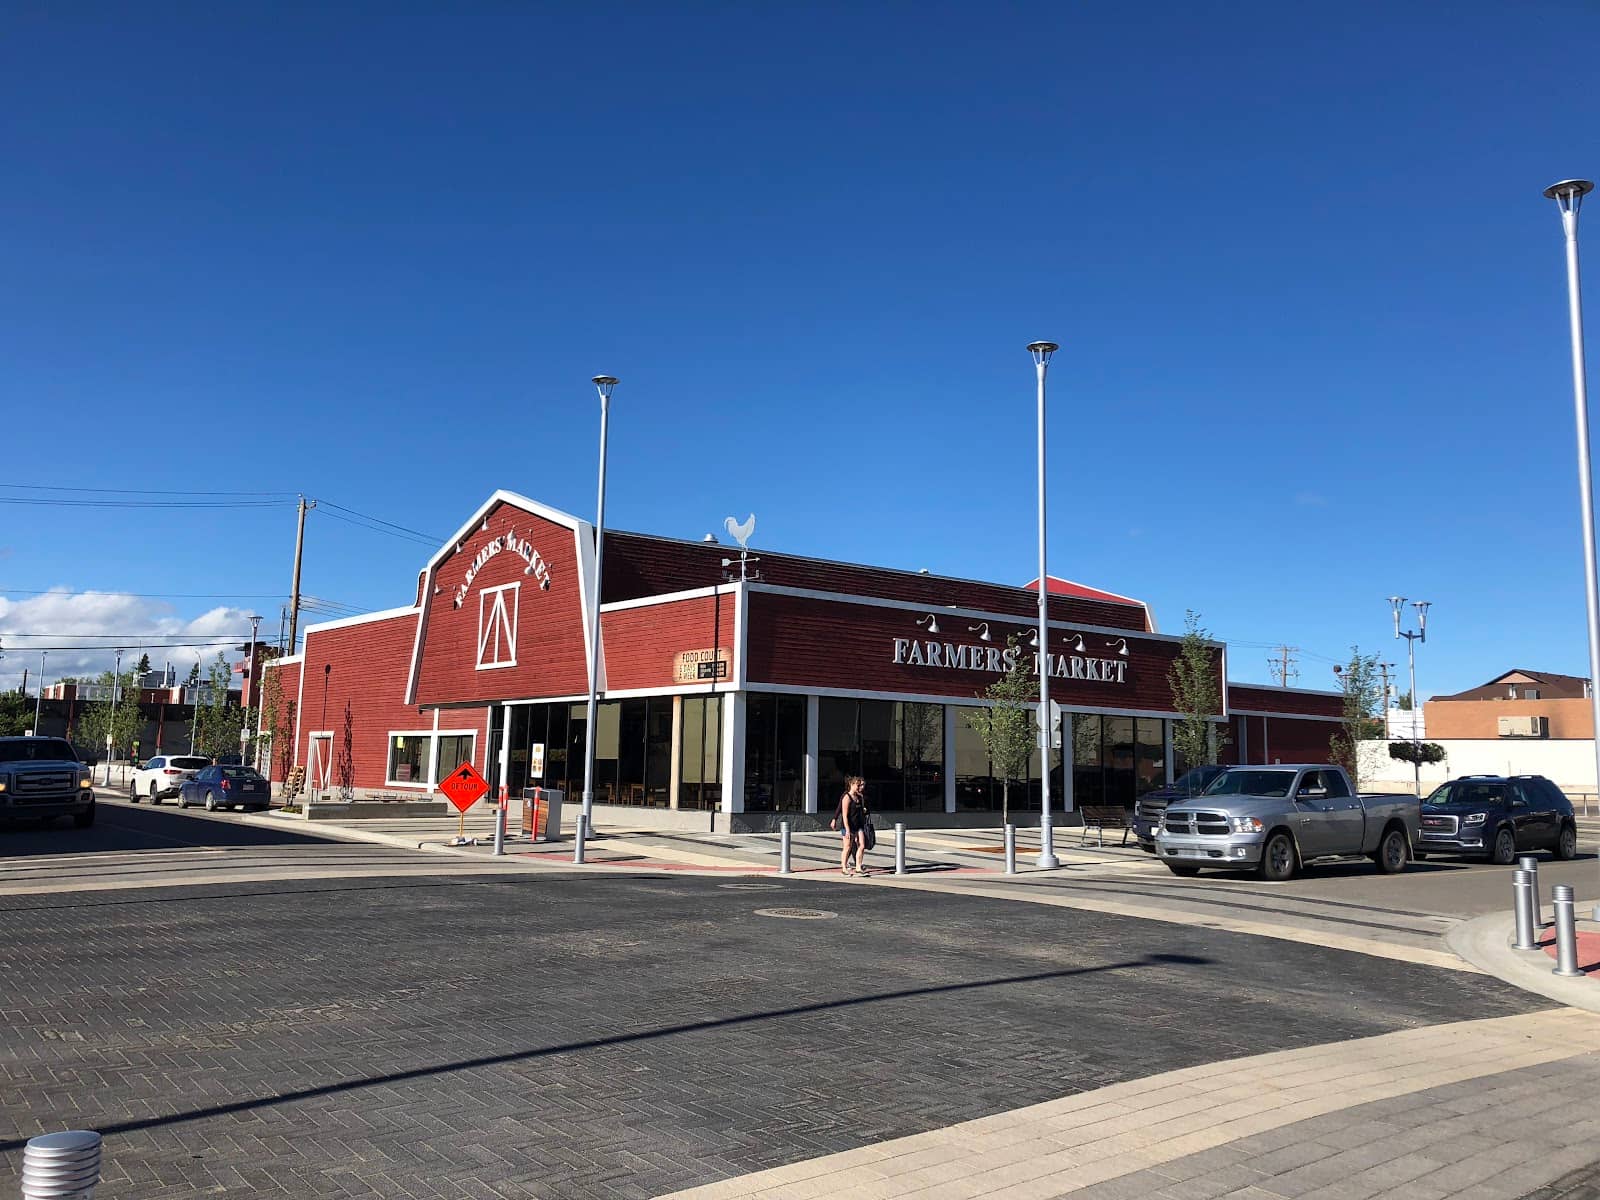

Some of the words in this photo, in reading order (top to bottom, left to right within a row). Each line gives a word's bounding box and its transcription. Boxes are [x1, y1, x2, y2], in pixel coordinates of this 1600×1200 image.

[454, 536, 505, 609] FARMERS'
[506, 536, 551, 591] MARKET
[682, 652, 699, 663] FOOD
[700, 649, 722, 661] COUT
[892, 637, 1022, 673] FARMERS'
[1032, 651, 1128, 683] MARKET
[683, 663, 696, 672] DAYS
[683, 672, 696, 680] WEEK
[452, 782, 477, 790] DETOUR
